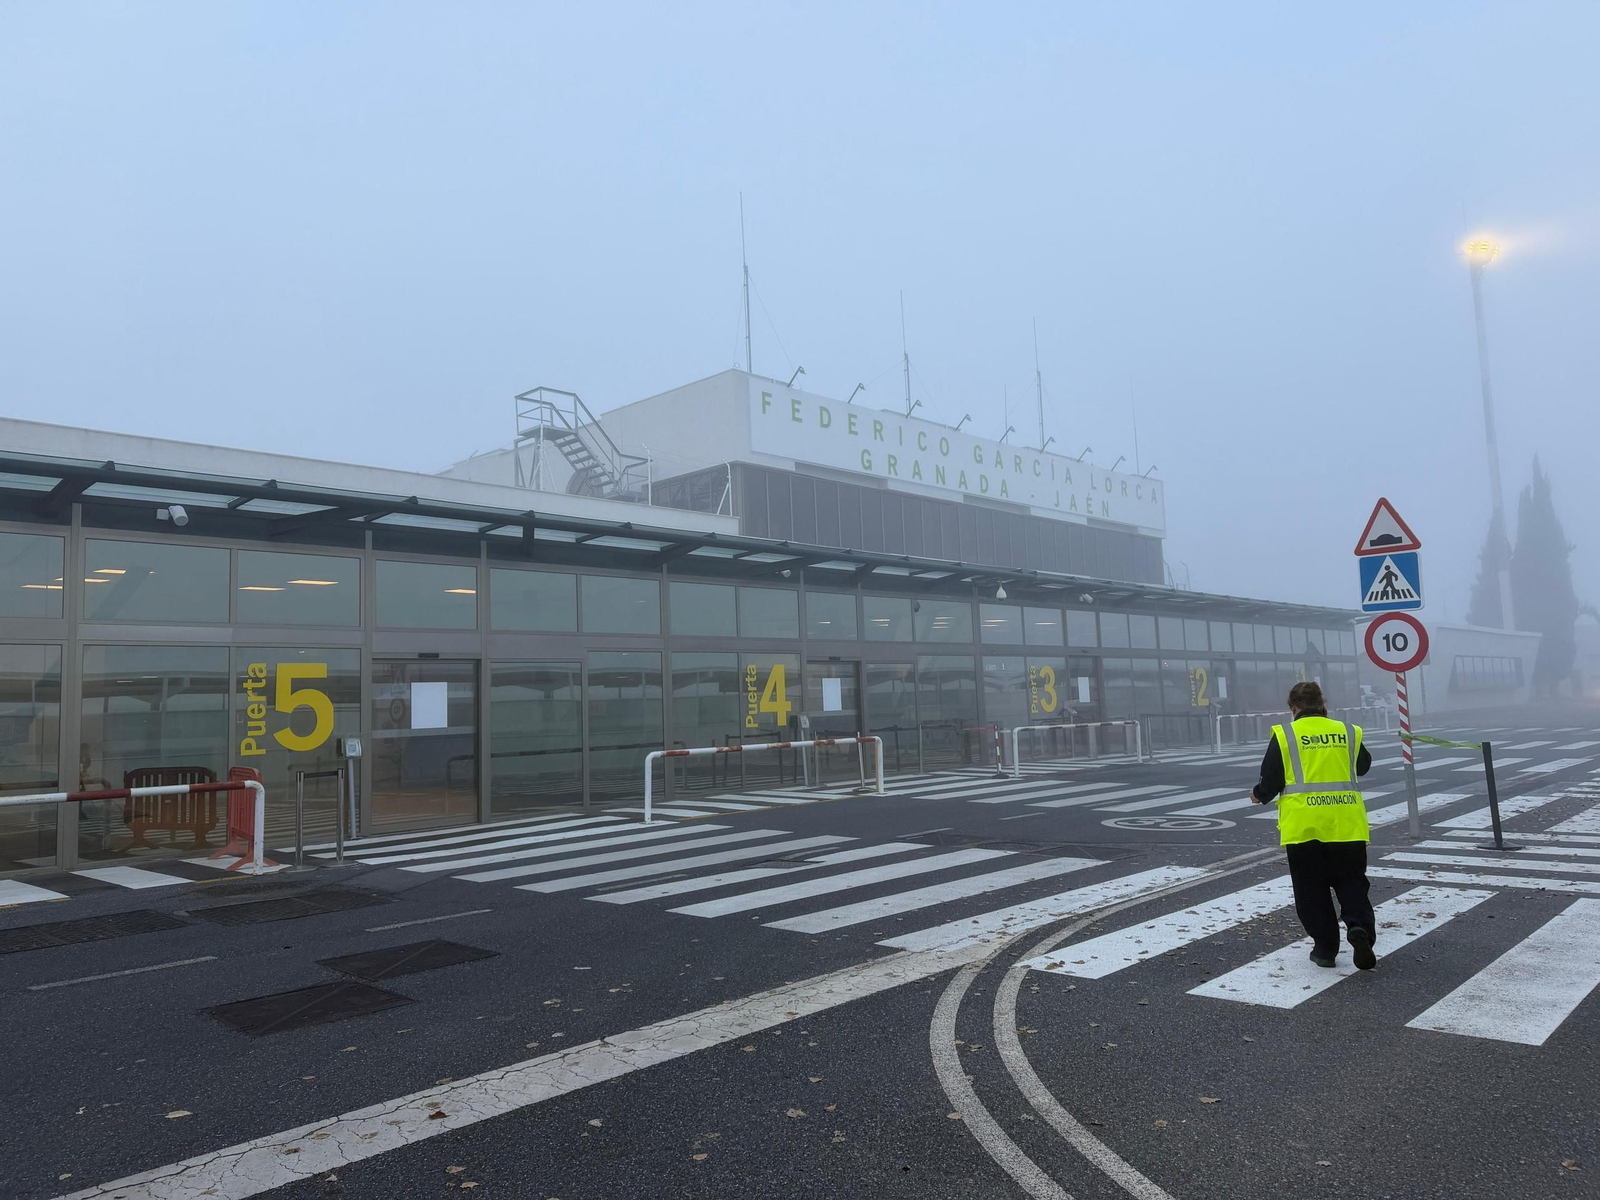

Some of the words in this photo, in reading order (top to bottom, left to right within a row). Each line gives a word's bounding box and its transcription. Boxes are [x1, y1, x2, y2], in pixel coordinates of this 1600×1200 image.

[761, 391, 950, 457] FEDERICO
[974, 444, 1073, 485] GARCÍA
[1090, 472, 1158, 504] LORCA
[860, 448, 1009, 498] GRANADA
[1054, 490, 1109, 517] JAÉN
[1382, 632, 1409, 652] 10
[240, 661, 267, 757] Puerta
[272, 662, 334, 752] 5
[745, 664, 758, 728] Puerta
[759, 664, 792, 727] 4
[1030, 665, 1039, 714] Puerta
[1039, 665, 1058, 713] 3
[1195, 668, 1210, 706] 2
[1116, 818, 1211, 829] 30
[1306, 792, 1357, 806] COORDINACIÓN
